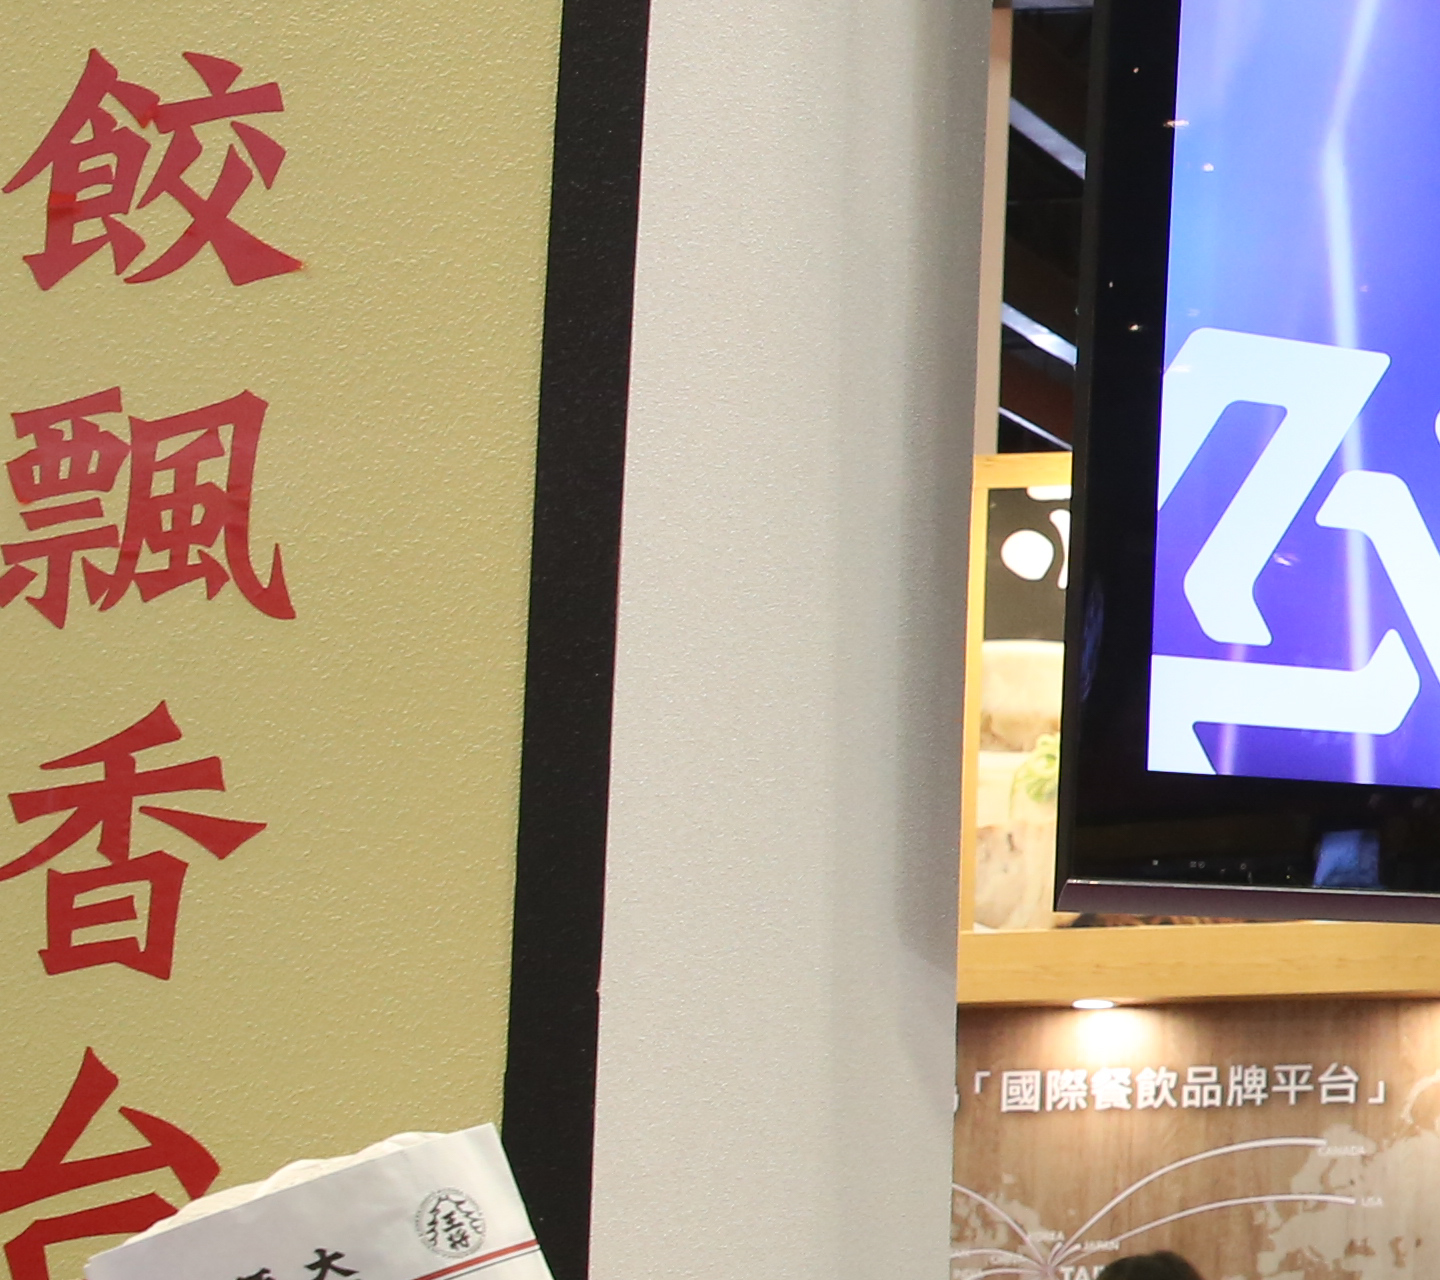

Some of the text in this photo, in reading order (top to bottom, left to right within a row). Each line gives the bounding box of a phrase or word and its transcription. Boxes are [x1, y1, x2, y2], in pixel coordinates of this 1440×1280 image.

[954, 1062, 1386, 1114] 「國際餐飲品牌平台」
